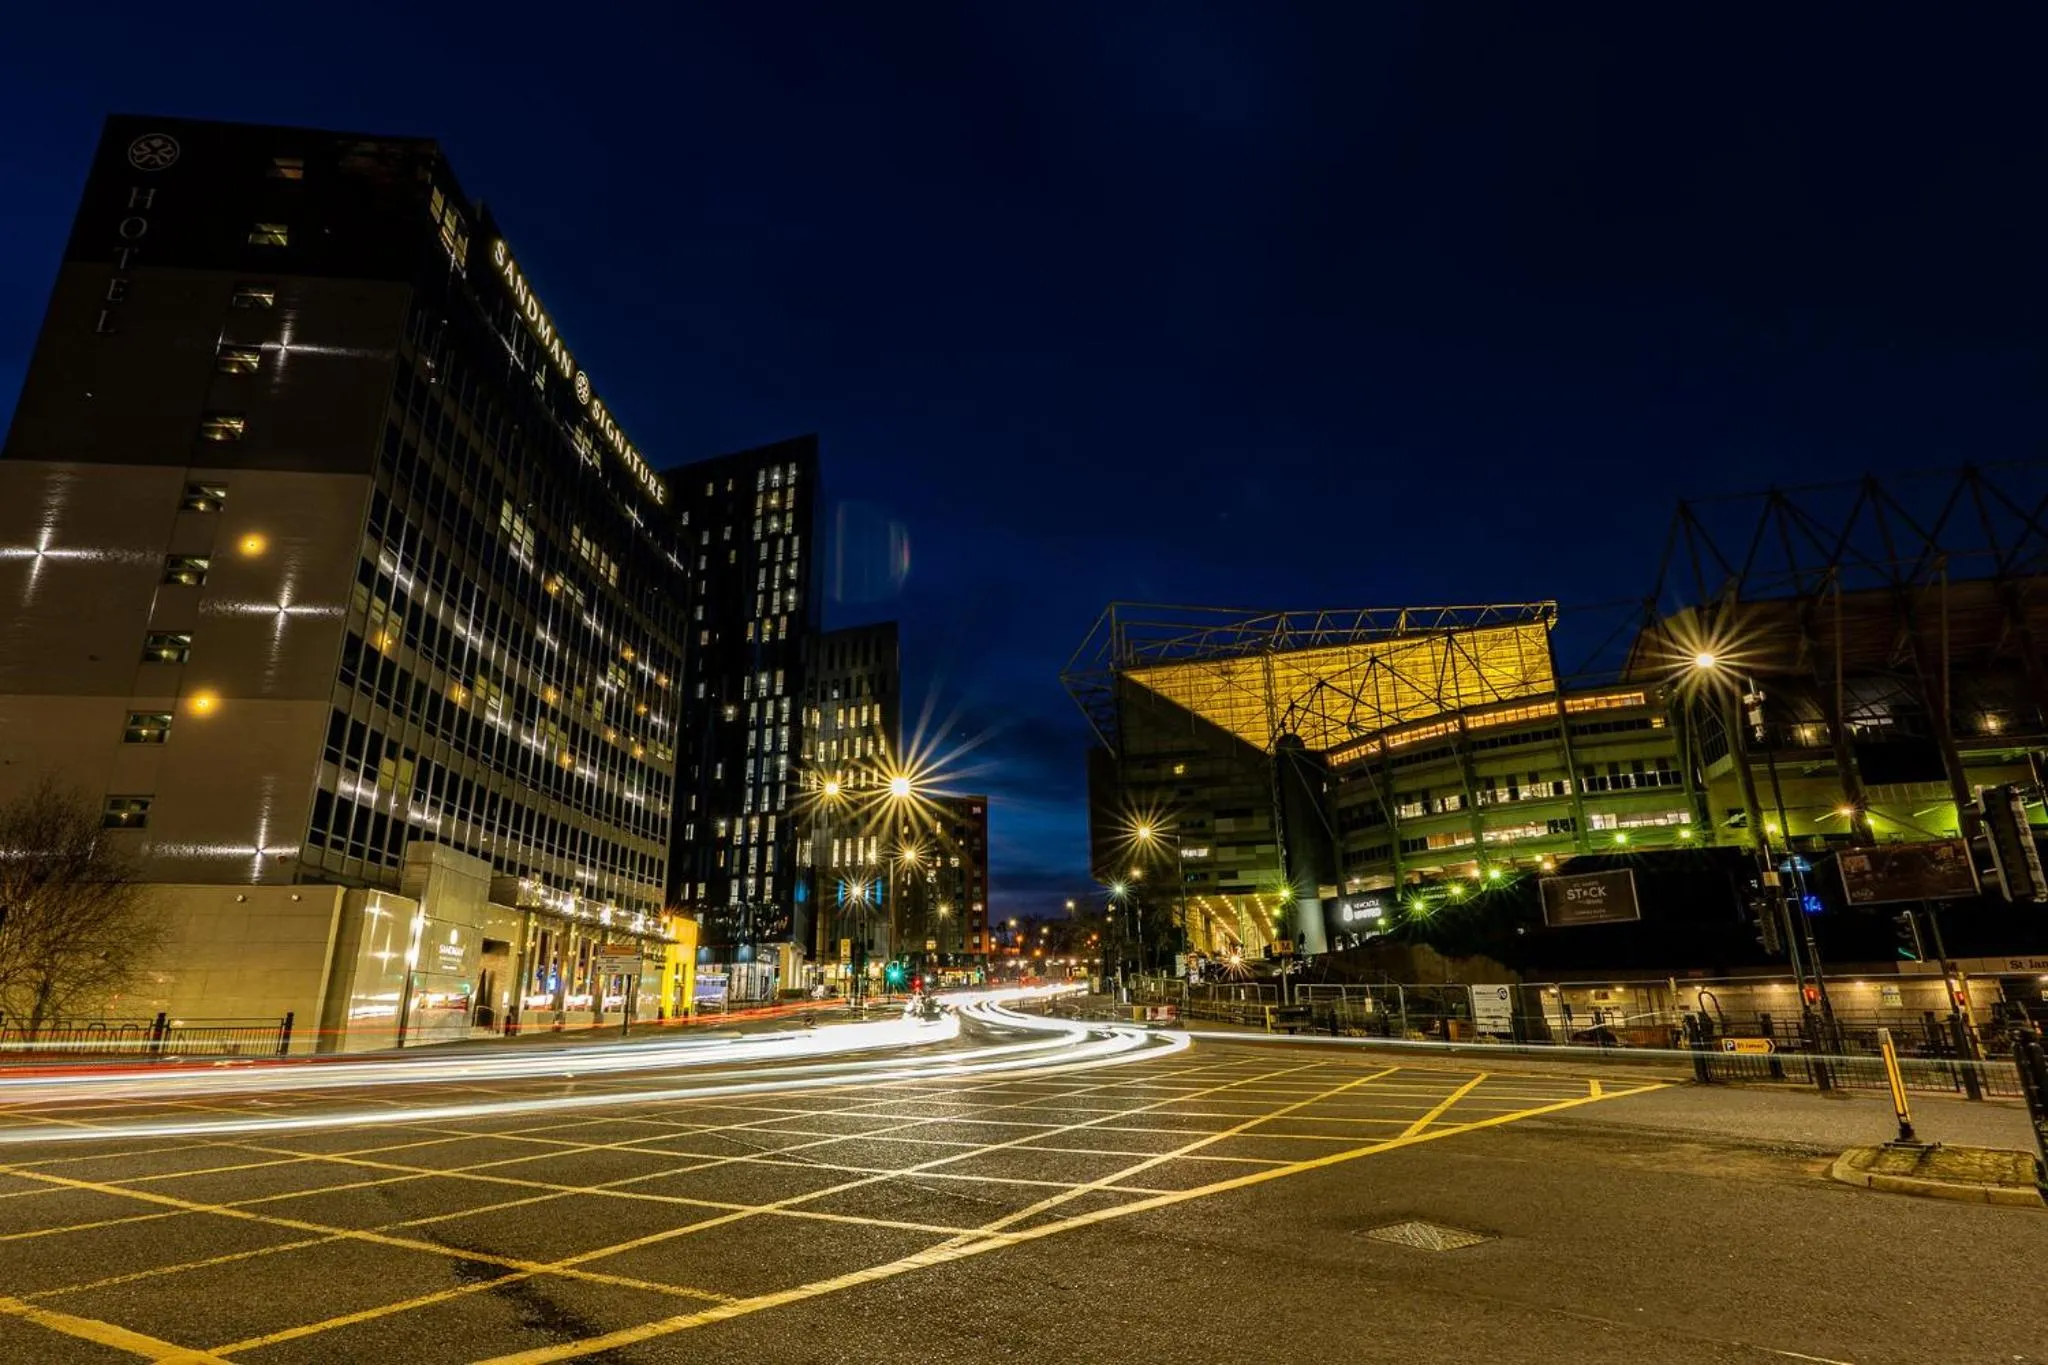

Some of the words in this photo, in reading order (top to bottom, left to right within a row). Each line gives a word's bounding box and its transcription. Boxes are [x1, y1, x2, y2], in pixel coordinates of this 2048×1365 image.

[94, 185, 162, 335] HOTEL
[494, 238, 574, 379] SANDMAN
[590, 397, 667, 507] SIGNATURE
[2009, 959, 2023, 969] St
